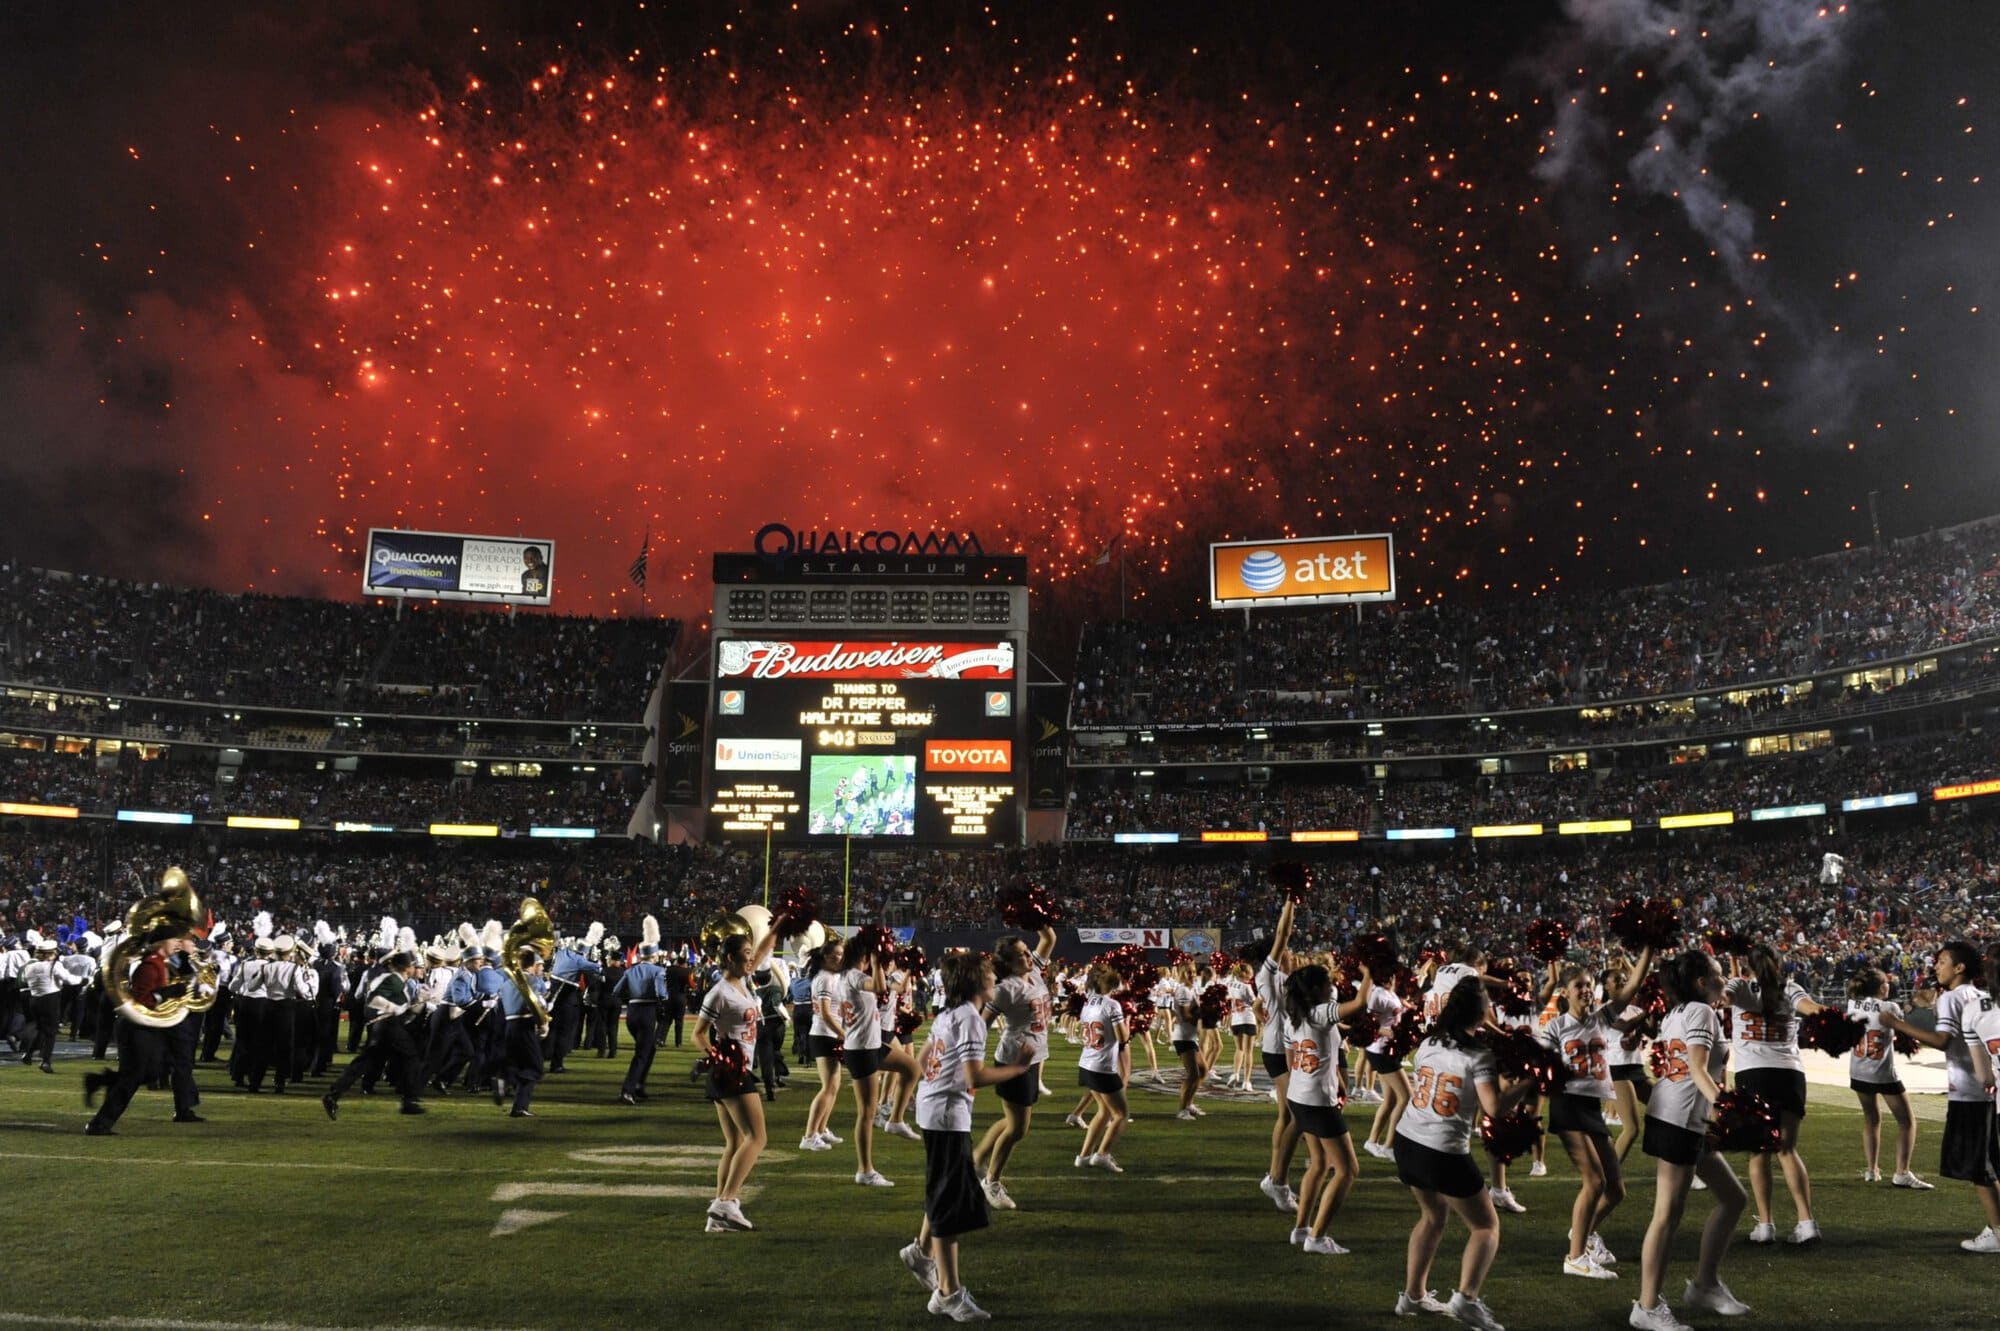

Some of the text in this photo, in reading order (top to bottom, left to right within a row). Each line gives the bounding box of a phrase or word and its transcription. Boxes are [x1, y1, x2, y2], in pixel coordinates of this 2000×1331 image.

[754, 523, 984, 554] QUALCOMM
[467, 543, 521, 555] PALOMAR
[375, 547, 457, 566] QUALCOMM
[466, 553, 521, 565] POMERADO
[390, 566, 443, 578] innovation
[465, 562, 521, 574] HEALTH
[802, 562, 966, 573] STADIUM
[1295, 551, 1368, 582] at&t
[469, 581, 515, 592] www.pph.org
[747, 642, 943, 678] Budweiser
[833, 683, 897, 695] THANKS TO
[822, 697, 906, 710] DR PEPPER
[800, 712, 932, 725] HALFTIME SHOW
[818, 730, 856, 746] 9:02
[738, 750, 799, 760] UnionBank
[930, 749, 1008, 764] TOYOTA
[946, 786, 987, 794] PACIFIC
[989, 786, 1014, 795] LIFE
[1936, 785, 1972, 799] WELLS
[1203, 832, 1265, 841] WELLS FARGO
[1143, 930, 1163, 947] N
[1855, 1000, 1881, 1012] BGA
[1564, 1038, 1607, 1080] 36
[1412, 1065, 1463, 1117] 36
